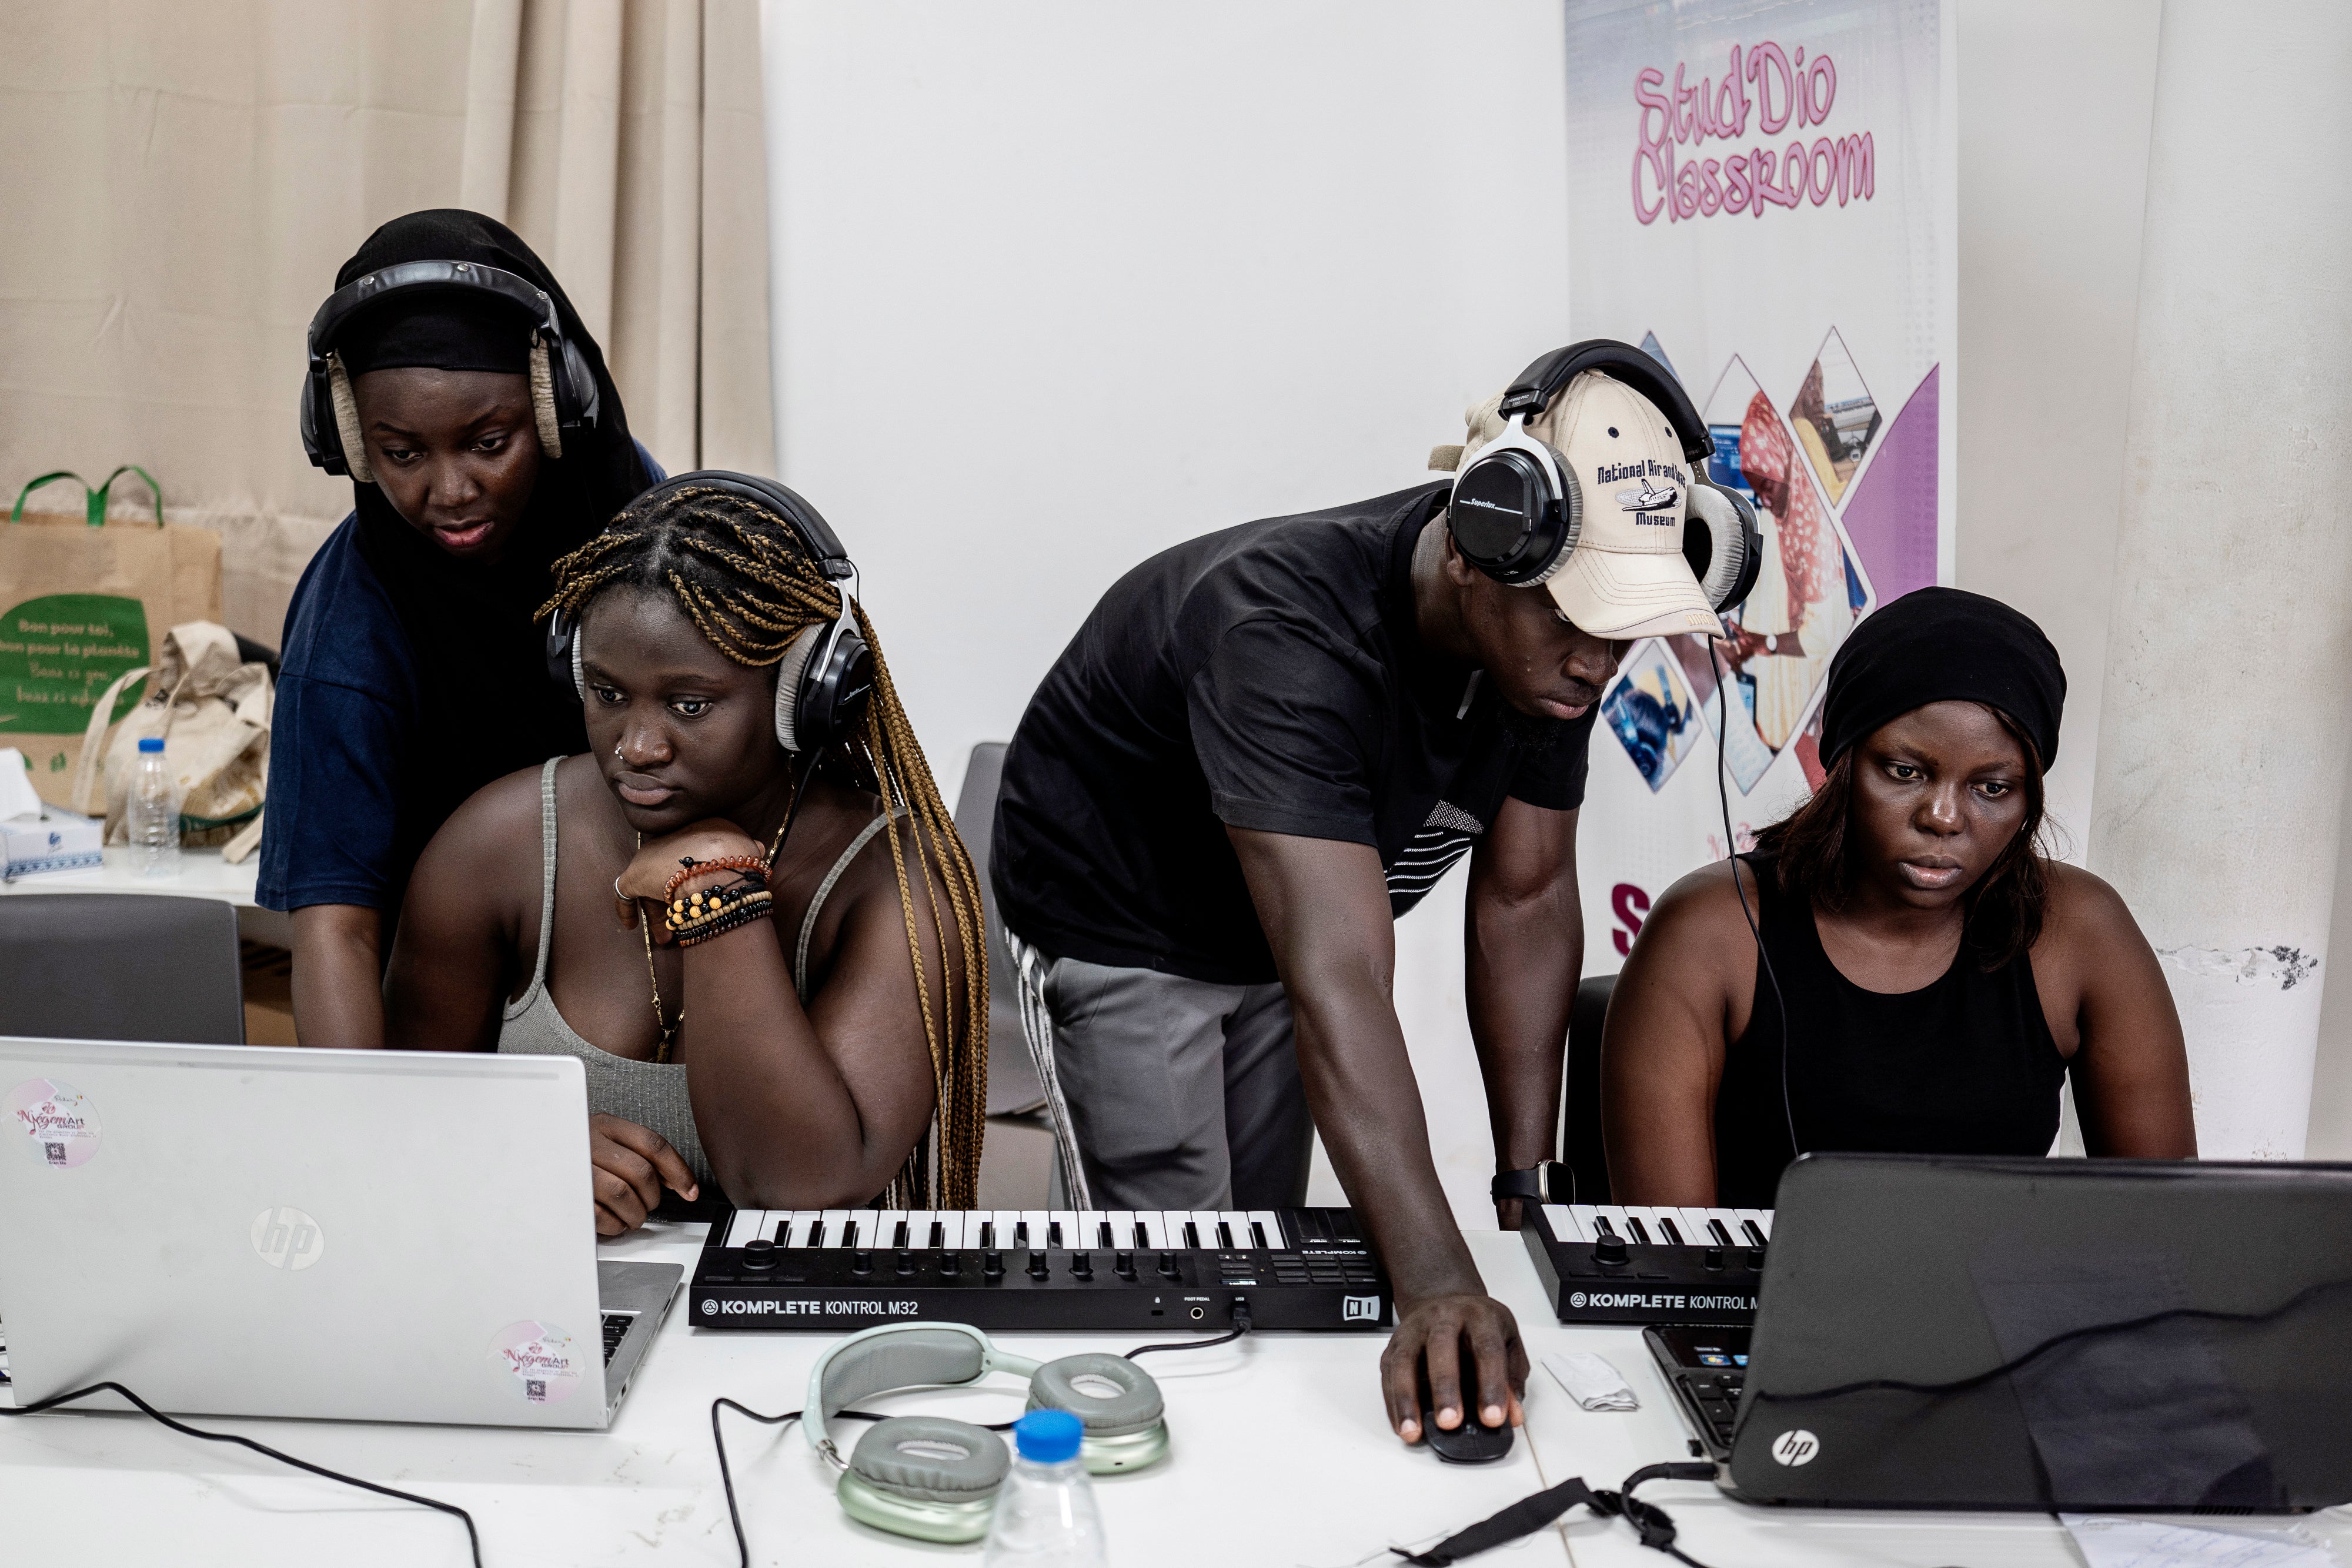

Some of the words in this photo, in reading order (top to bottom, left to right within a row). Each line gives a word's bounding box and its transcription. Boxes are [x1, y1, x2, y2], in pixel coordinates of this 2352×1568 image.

[1598, 460, 1646, 484] National
[1648, 459, 1661, 477] Air
[1662, 463, 1675, 480] and
[1470, 498, 1496, 509] Superlux
[1636, 511, 1676, 527] Museum
[260, 1206, 318, 1271] hp
[721, 1300, 820, 1315] KOMPLETE
[825, 1301, 886, 1315] KONTROL
[888, 1301, 918, 1315] M32
[1589, 1293, 1685, 1308] KOMPLETE
[1689, 1296, 1747, 1309] KONTROL
[1780, 1430, 1813, 1466] hp
